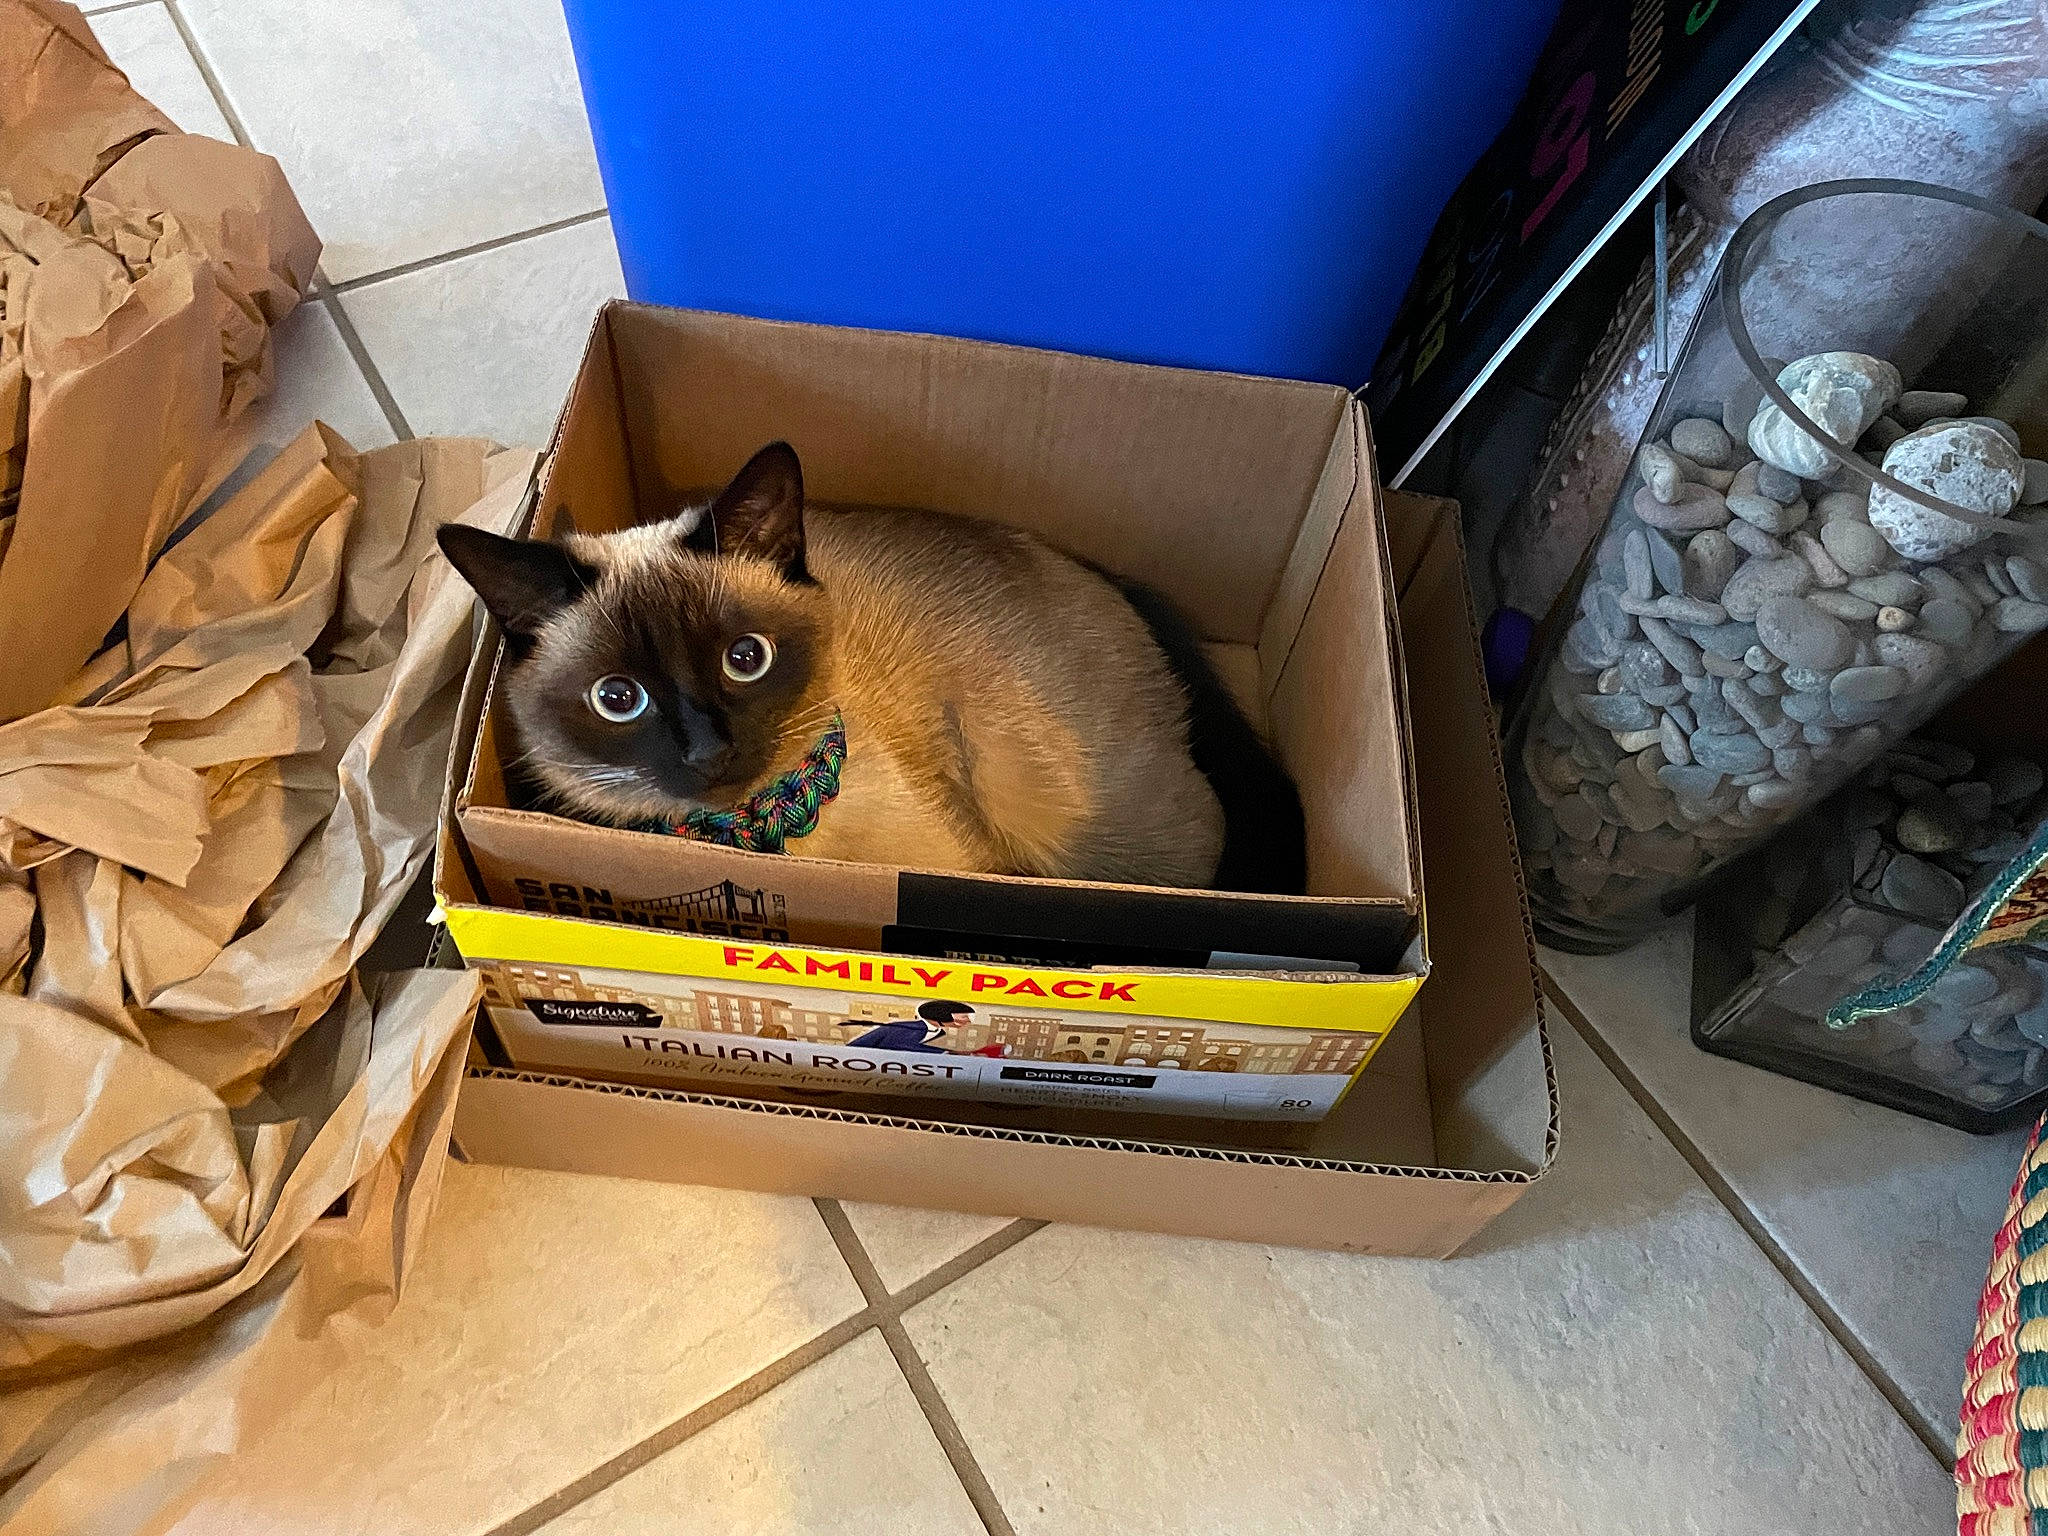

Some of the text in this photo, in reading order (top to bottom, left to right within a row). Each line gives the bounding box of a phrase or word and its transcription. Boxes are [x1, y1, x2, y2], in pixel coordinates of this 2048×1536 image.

[514, 878, 613, 904] SAN
[722, 945, 951, 989] FAMILY
[970, 972, 1142, 1002] PACK
[543, 1003, 638, 1021] Signature
[622, 1034, 964, 1080] ITALIAN ROAST
[1025, 1071, 1136, 1084] DARK ROAST
[1281, 1099, 1312, 1108] 80
